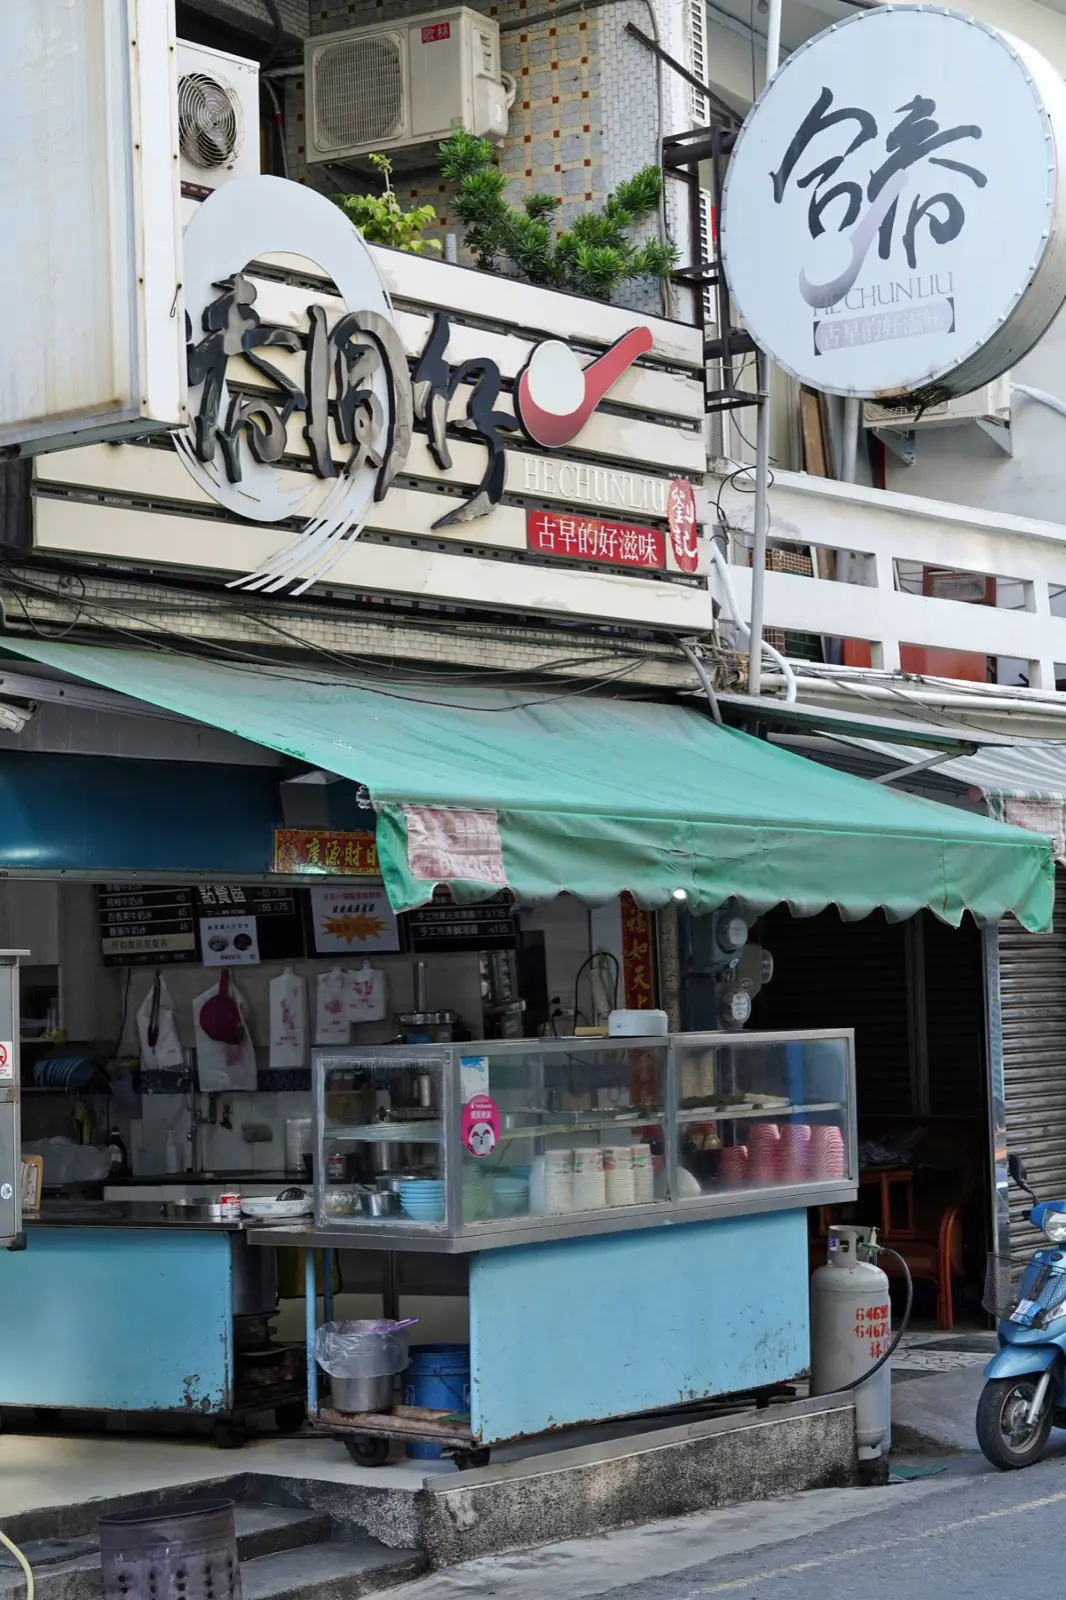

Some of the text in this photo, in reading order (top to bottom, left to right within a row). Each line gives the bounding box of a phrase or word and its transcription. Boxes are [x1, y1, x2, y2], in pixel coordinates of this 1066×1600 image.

[823, 307, 945, 349] 古早的好滋味
[536, 515, 658, 564] 古早的好滋味
[177, 908, 187, 917] 45
